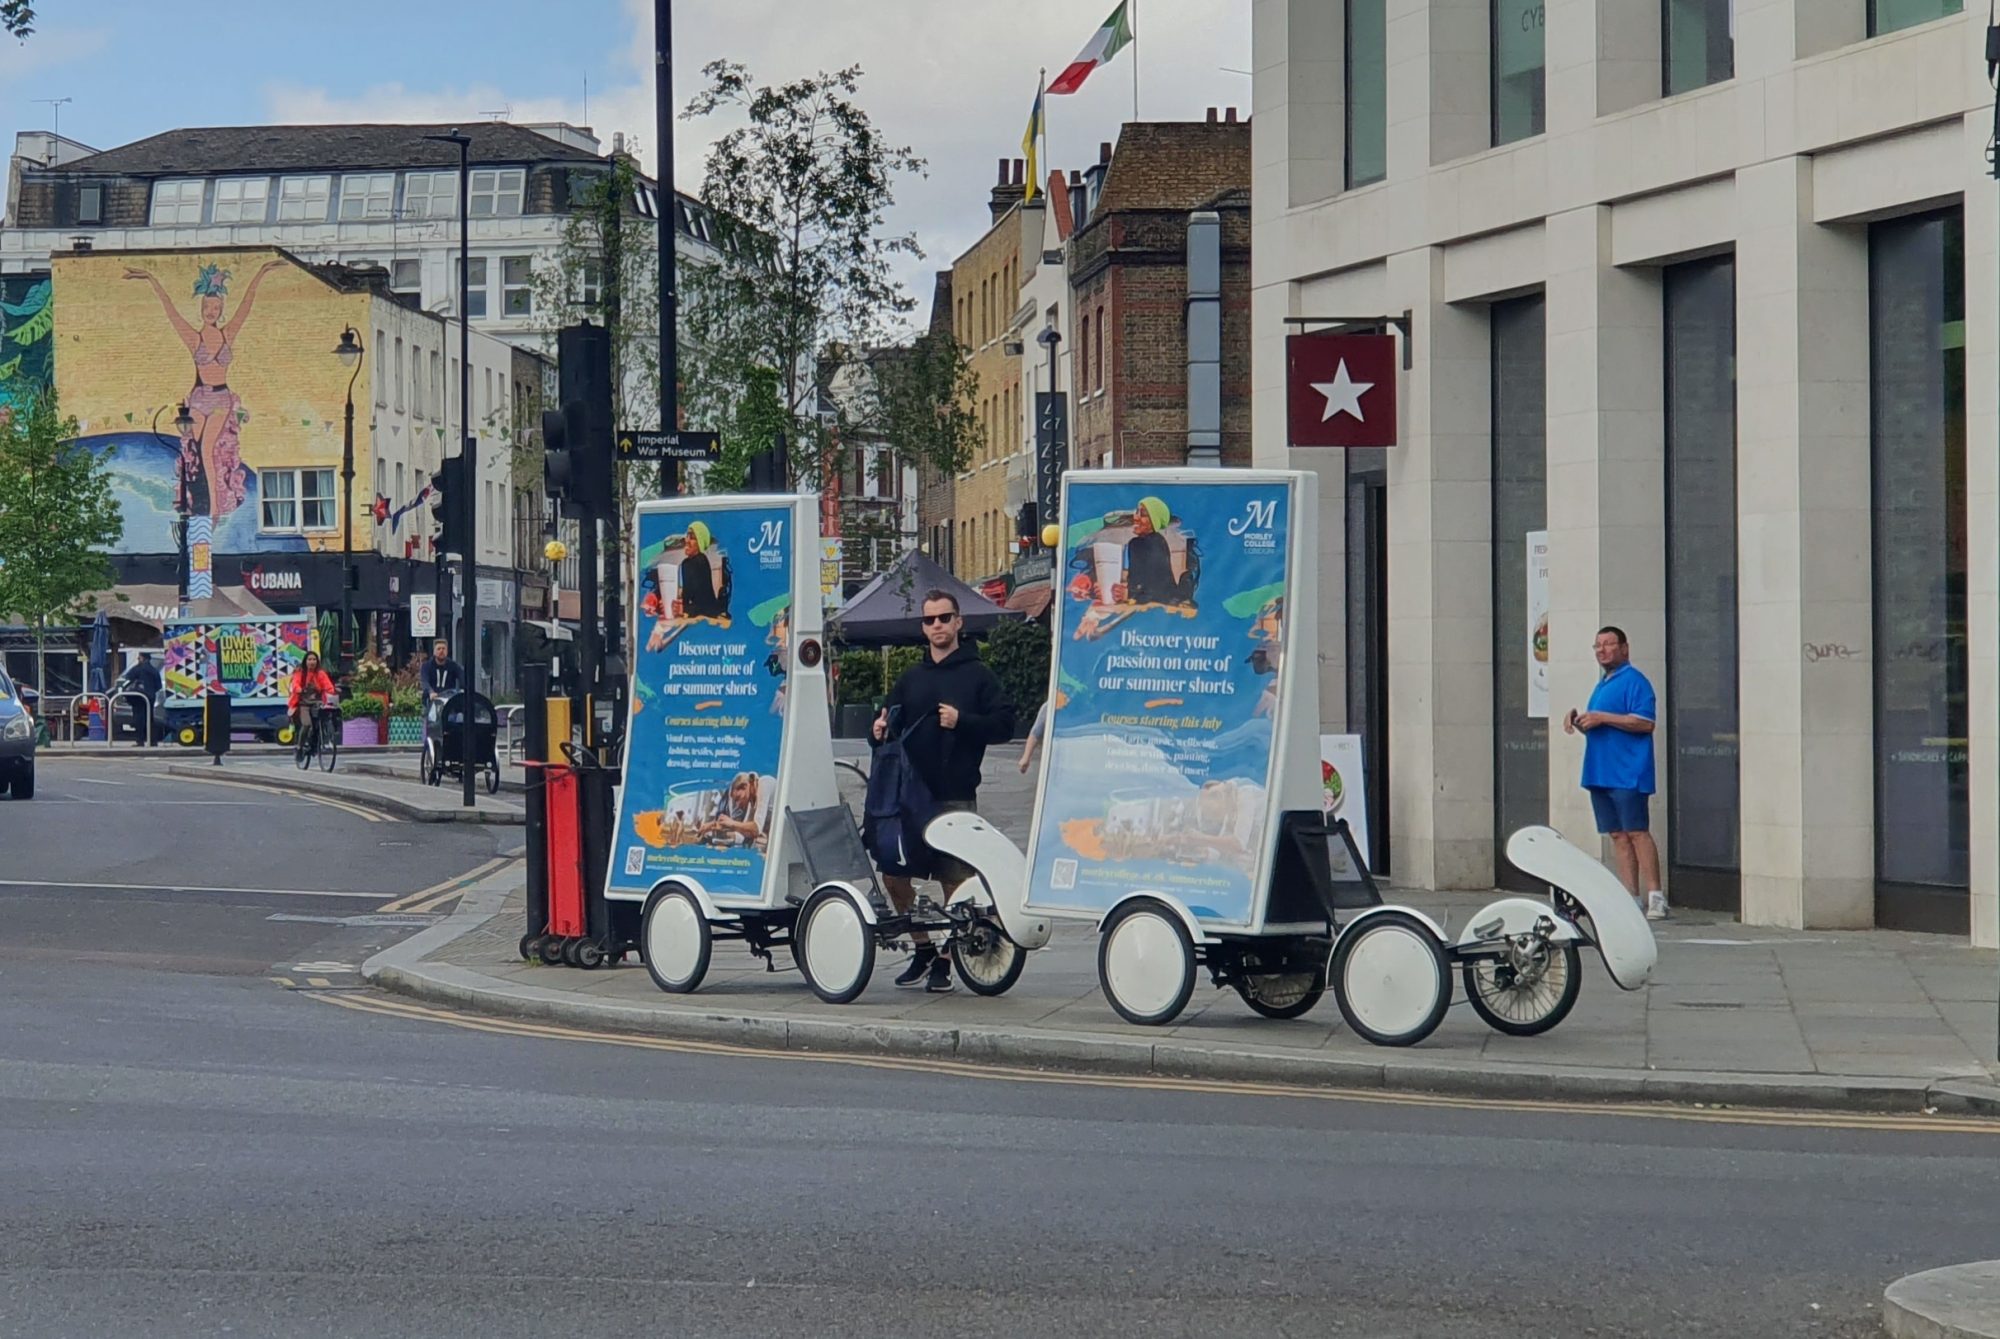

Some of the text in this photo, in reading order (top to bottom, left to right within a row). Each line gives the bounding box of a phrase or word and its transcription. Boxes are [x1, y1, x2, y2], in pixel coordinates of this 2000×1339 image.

[637, 434, 680, 445] Imperial
[637, 446, 706, 457] War Museum
[1228, 500, 1278, 536] M
[748, 520, 783, 553] M
[1244, 540, 1275, 548] COLLEGE
[251, 572, 302, 589] CUBANA
[220, 635, 256, 650] LOWER
[678, 641, 747, 660] Discover your
[1121, 630, 1219, 653] Discover your
[221, 649, 257, 664] MARSH
[1106, 651, 1232, 672] passion on one of
[669, 660, 756, 680] passion on one of
[663, 680, 758, 696] our summer shorts
[1098, 676, 1235, 695] our summer shorts
[1101, 712, 1223, 732] Courses starting this July
[1185, 766, 1210, 777] more!
